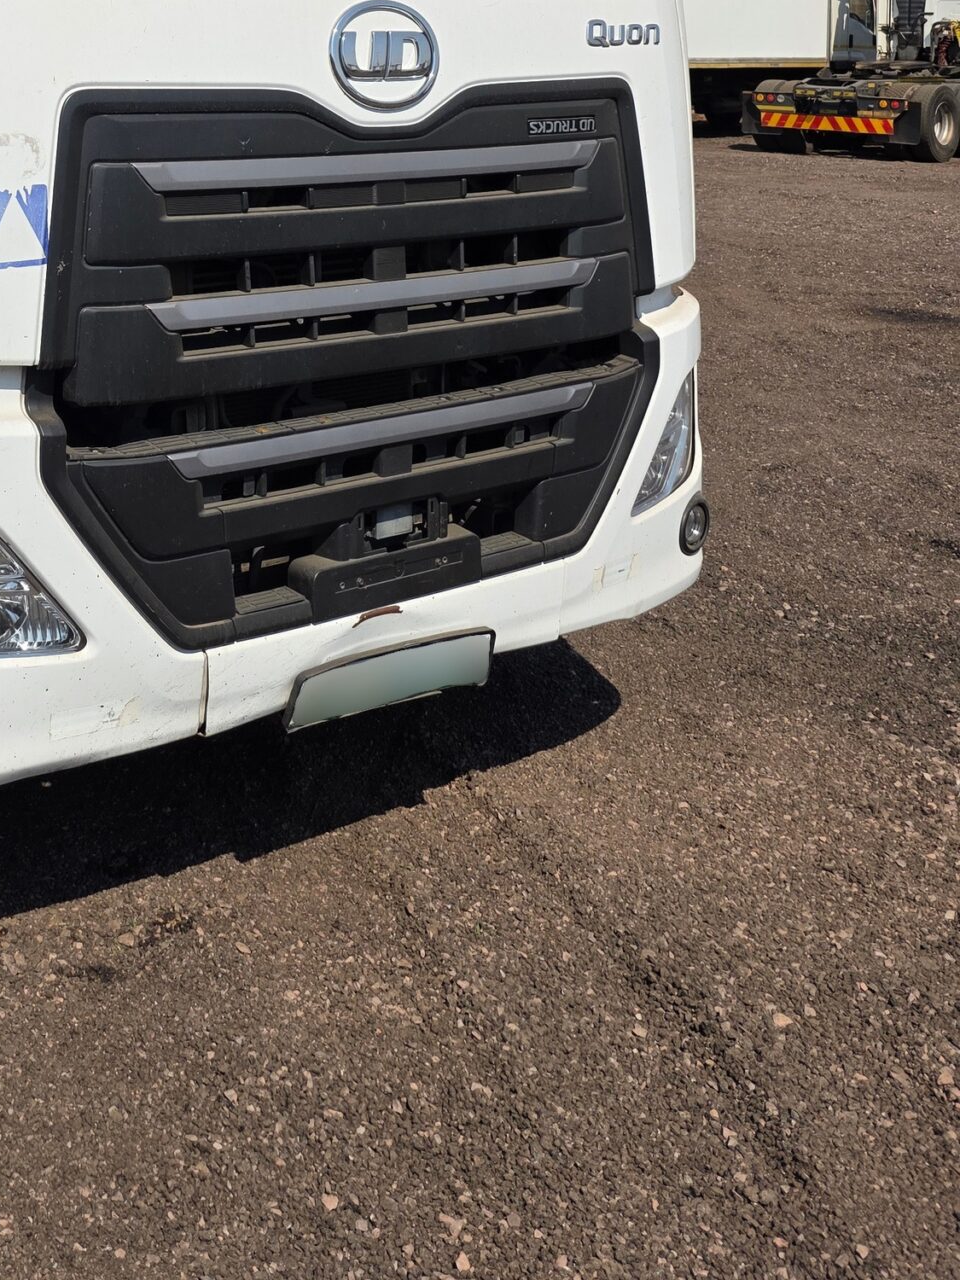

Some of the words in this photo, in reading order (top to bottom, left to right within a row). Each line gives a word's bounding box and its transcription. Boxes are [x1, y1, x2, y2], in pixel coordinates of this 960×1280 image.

[586, 19, 661, 48] Quon
[340, 31, 432, 82] UD
[529, 120, 578, 134] TRUCKS
[580, 119, 595, 131] UD
